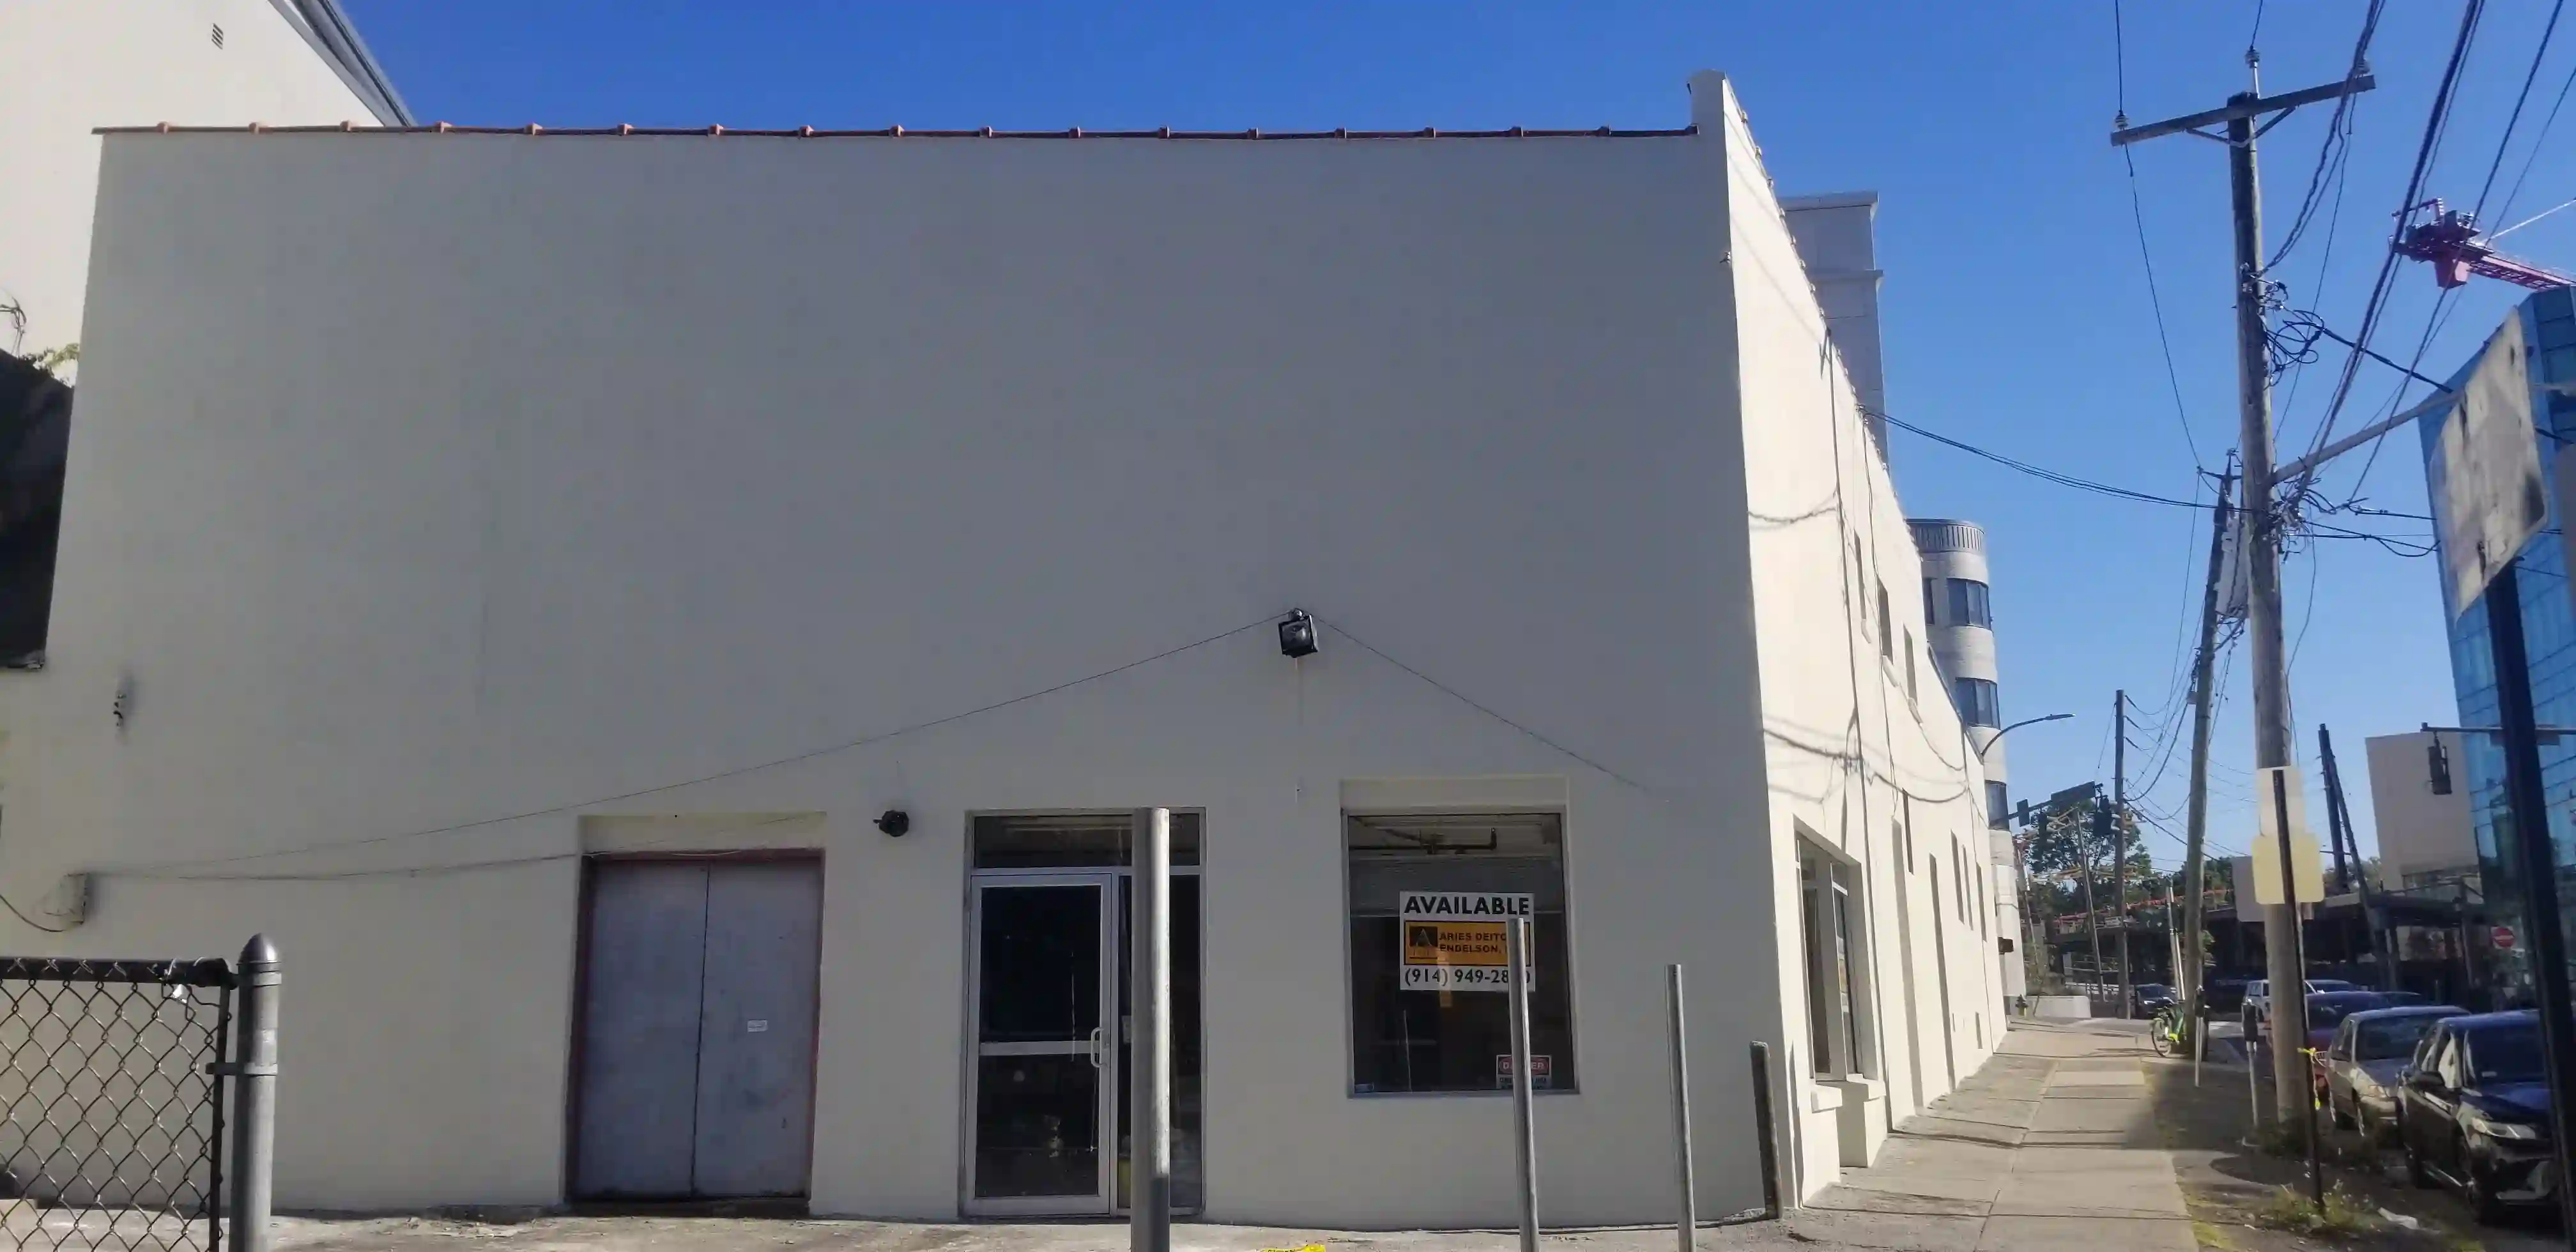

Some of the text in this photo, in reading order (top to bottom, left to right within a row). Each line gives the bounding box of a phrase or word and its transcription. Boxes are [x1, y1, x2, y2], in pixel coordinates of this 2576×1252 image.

[1404, 896, 1529, 915] AVAILABLE
[1439, 933, 1506, 942] ARIES DEITC
[1405, 968, 1531, 986] (914) 949-28
[1502, 1061, 1545, 1070] DER
